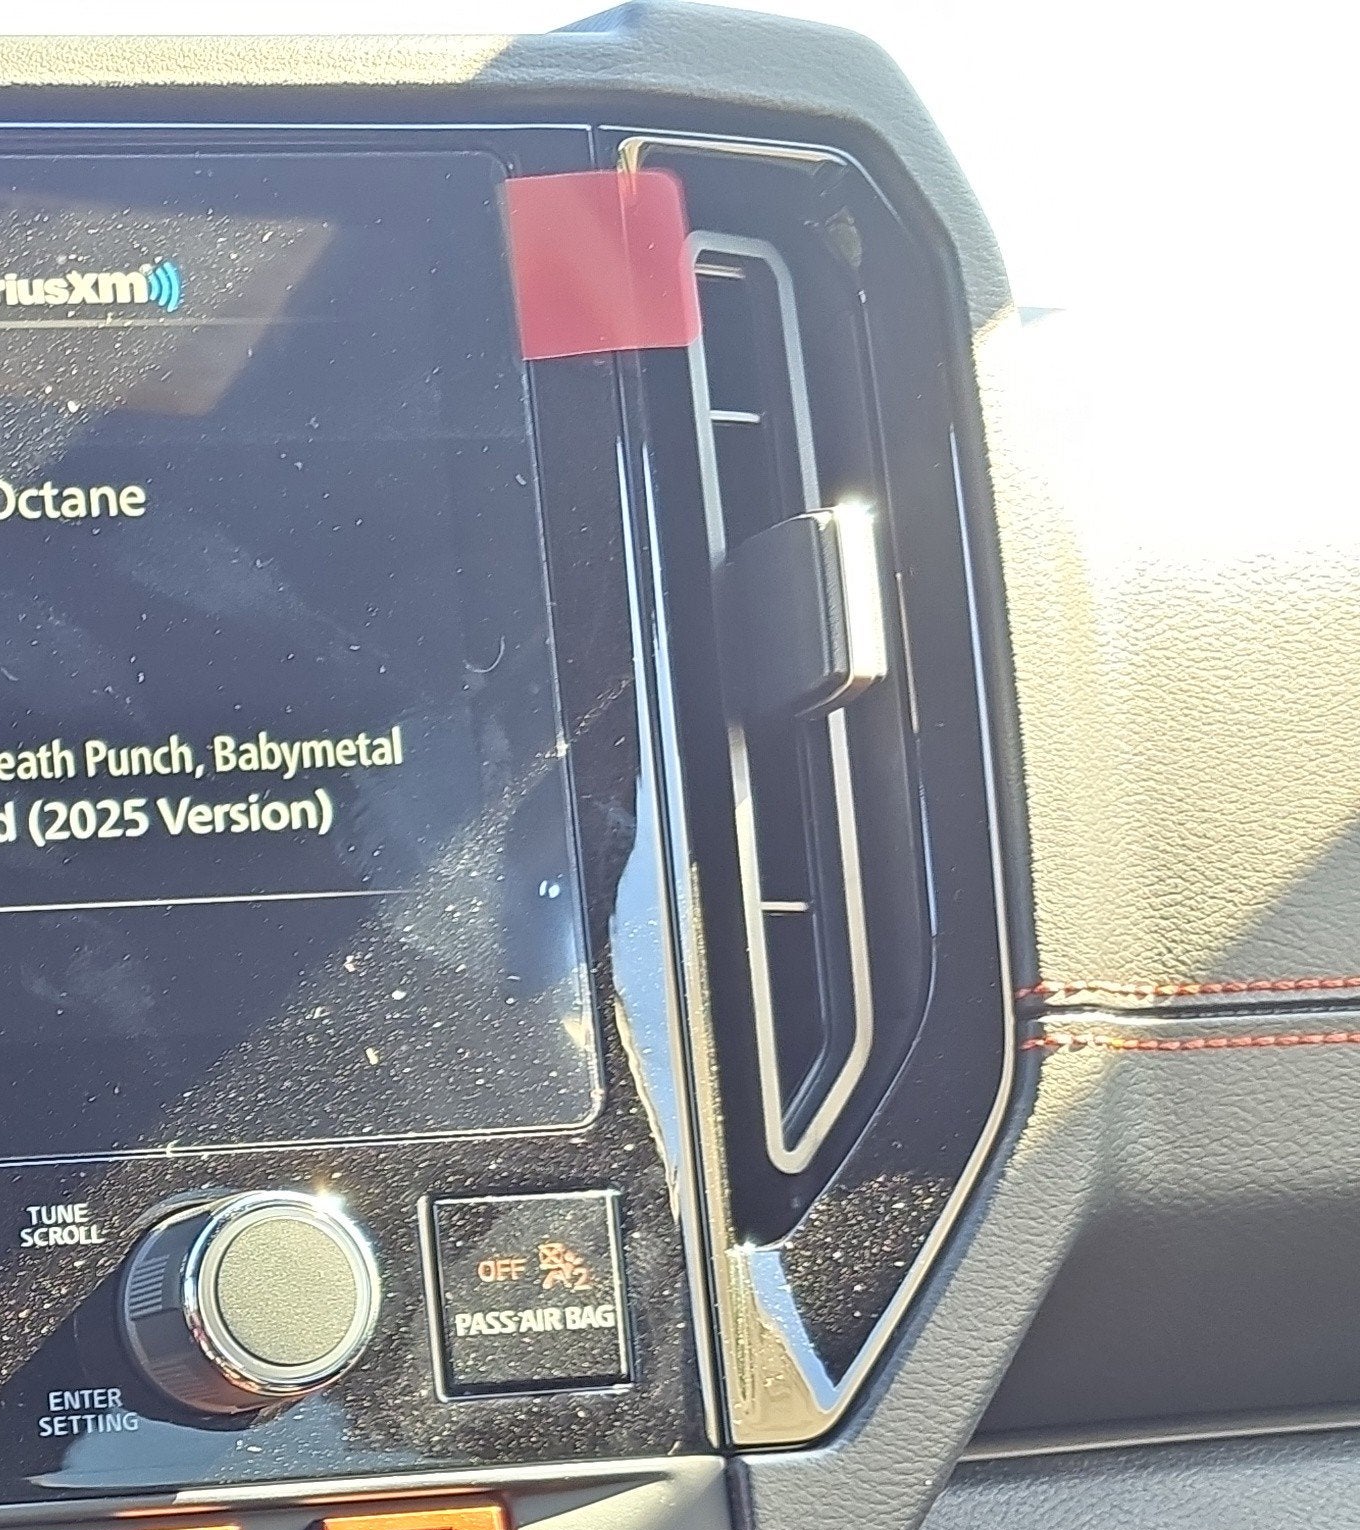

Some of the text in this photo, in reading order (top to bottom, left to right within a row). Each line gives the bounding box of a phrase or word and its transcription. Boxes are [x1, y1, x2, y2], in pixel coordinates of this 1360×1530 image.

[86, 737, 204, 779] Punch,
[214, 727, 403, 774] Babymetal
[28, 798, 149, 848] (2025
[158, 789, 333, 837] Version)
[27, 1203, 89, 1226] TUNE
[20, 1223, 106, 1247] SCROLL
[478, 1256, 528, 1283] OFF
[517, 1307, 565, 1333] AIR
[565, 1304, 617, 1330] BAG
[48, 1387, 123, 1413] ENTER
[38, 1410, 140, 1438] SETTING
